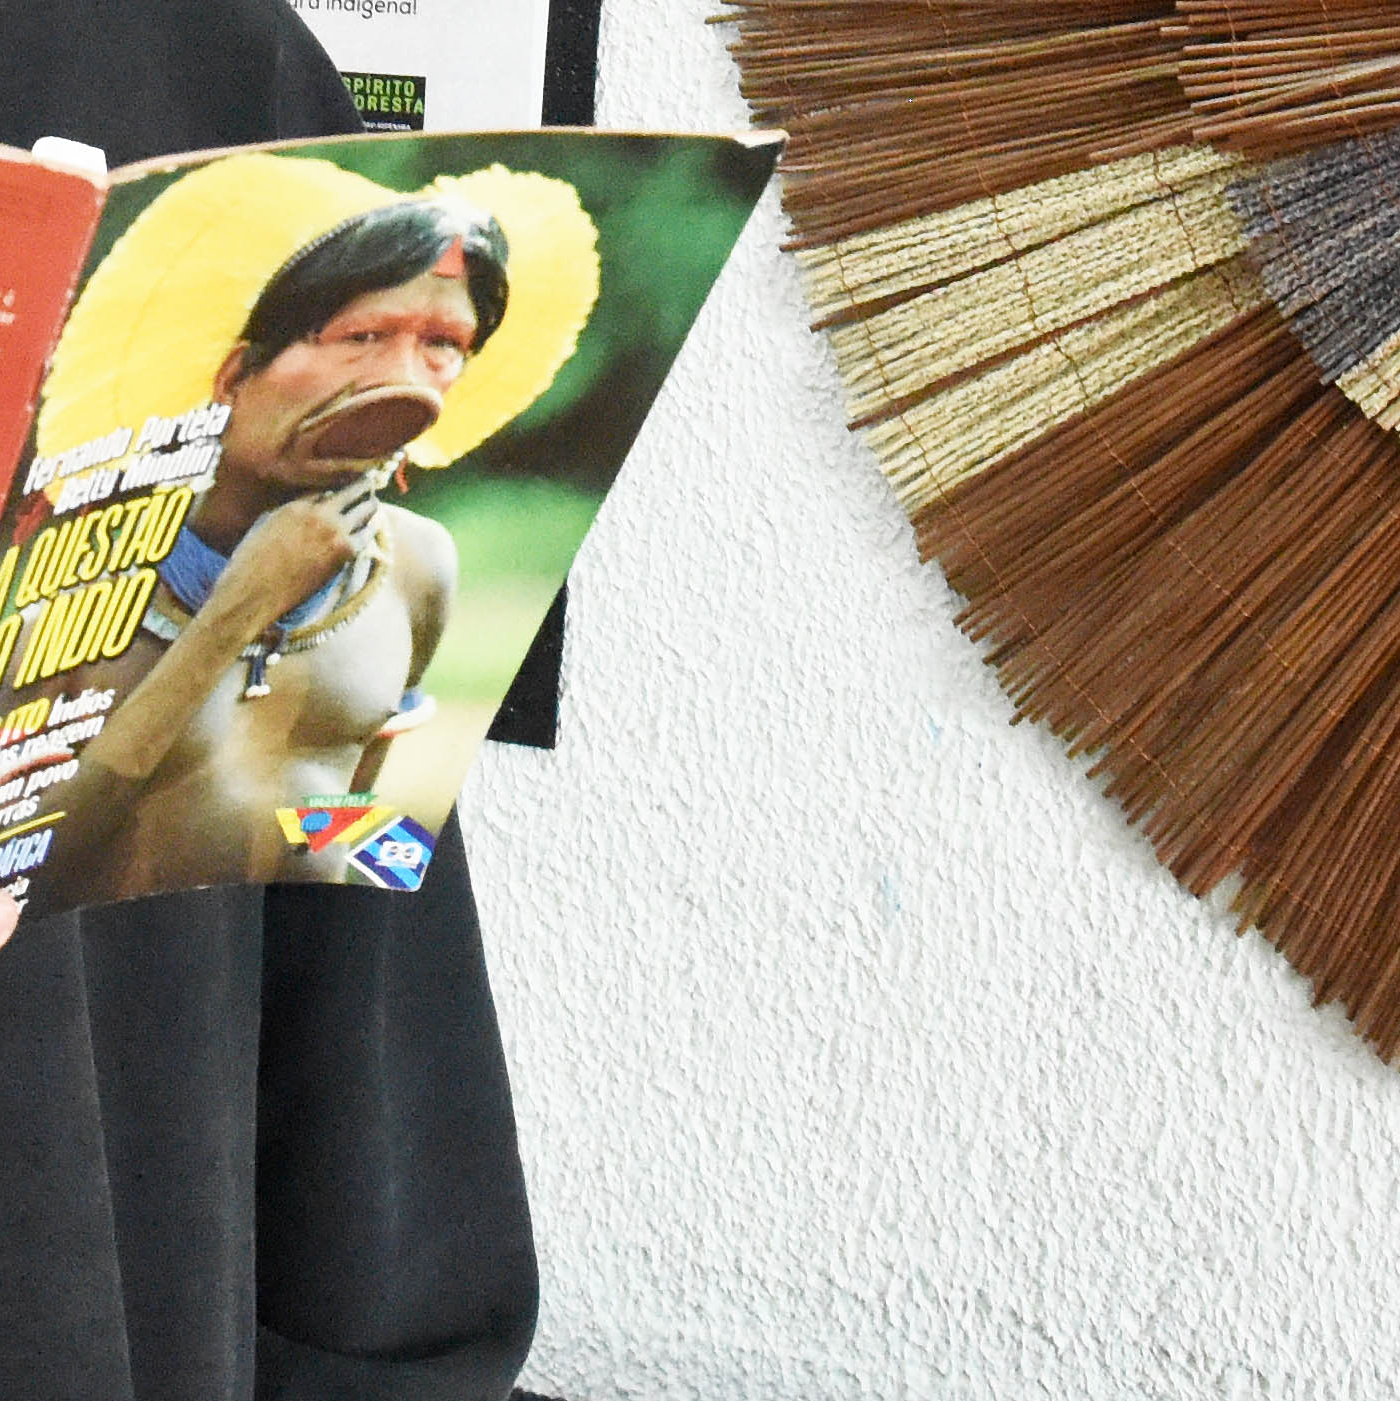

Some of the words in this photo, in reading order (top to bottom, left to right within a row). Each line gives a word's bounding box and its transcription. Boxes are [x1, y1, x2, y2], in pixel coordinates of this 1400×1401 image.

[343, 75, 416, 98] SPÍRITO
[353, 95, 425, 115] ORESTA
[15, 484, 194, 610] QUESTÃO
[23, 759, 80, 798] povo
